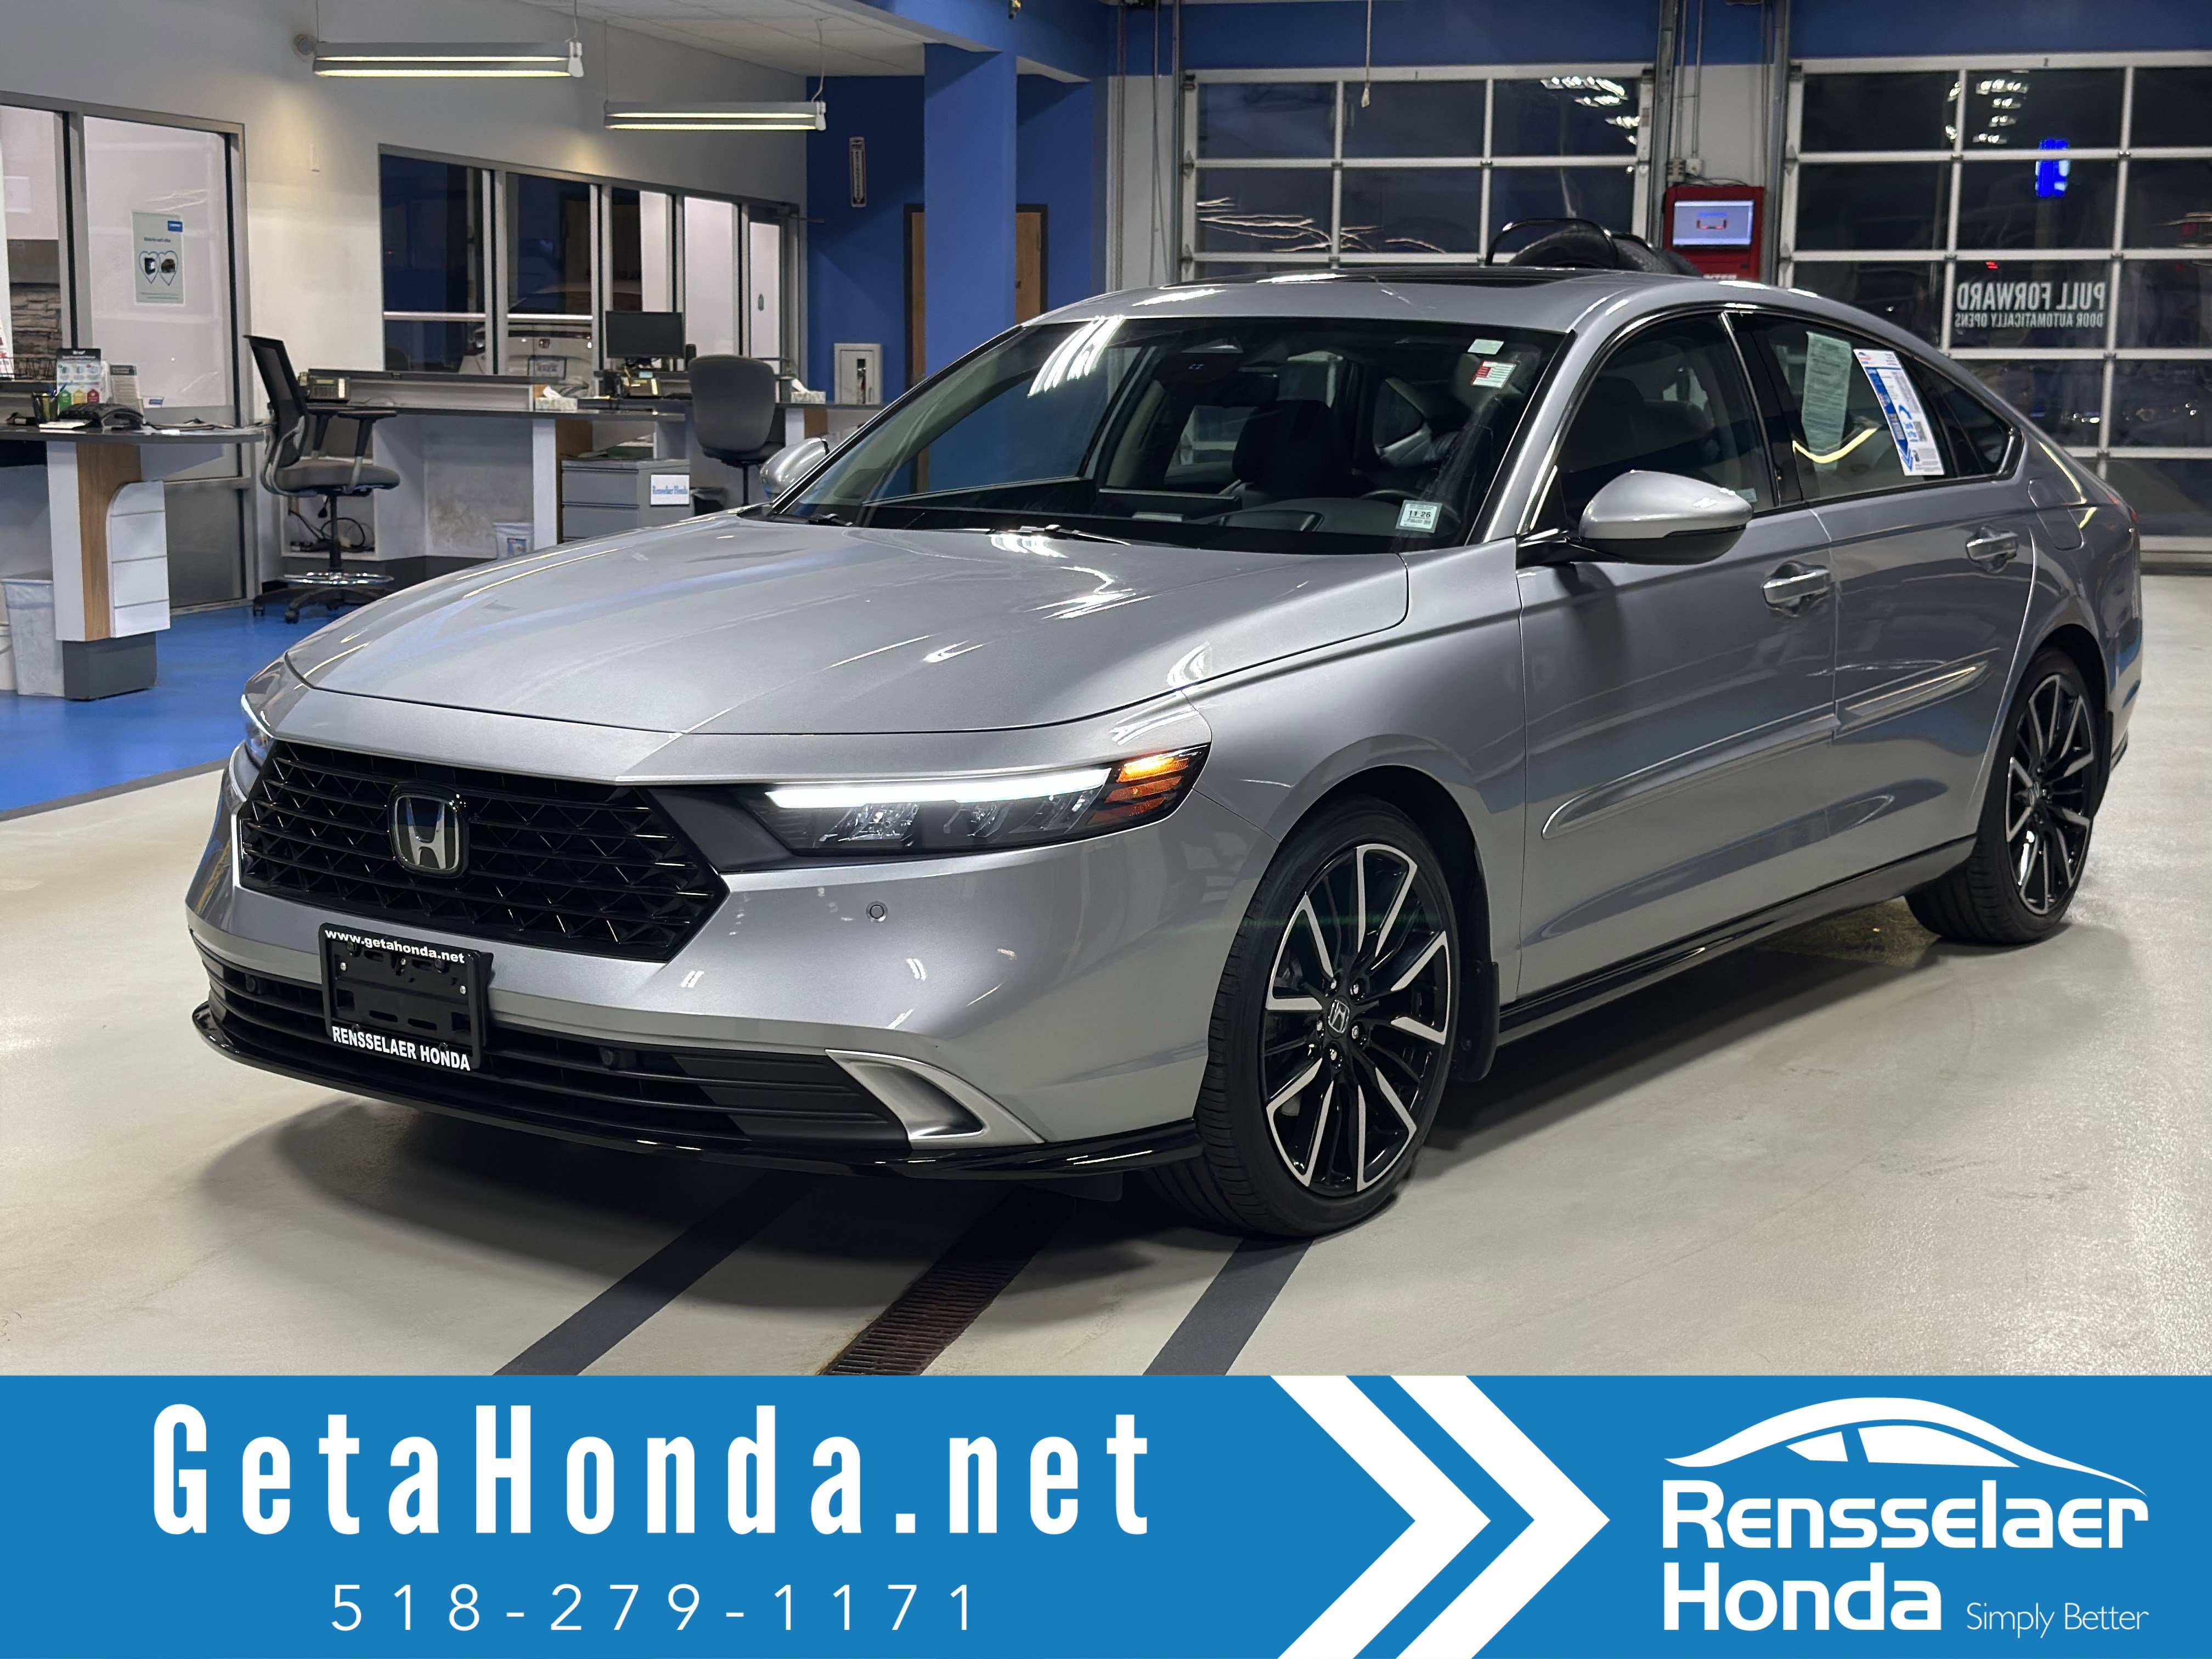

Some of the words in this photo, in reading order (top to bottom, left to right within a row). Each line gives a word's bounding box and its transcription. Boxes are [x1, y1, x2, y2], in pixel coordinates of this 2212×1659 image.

[325, 929, 465, 964] www.getahonda.net
[332, 1026, 417, 1060] RENSSELAER
[420, 1044, 471, 1071] HONDA
